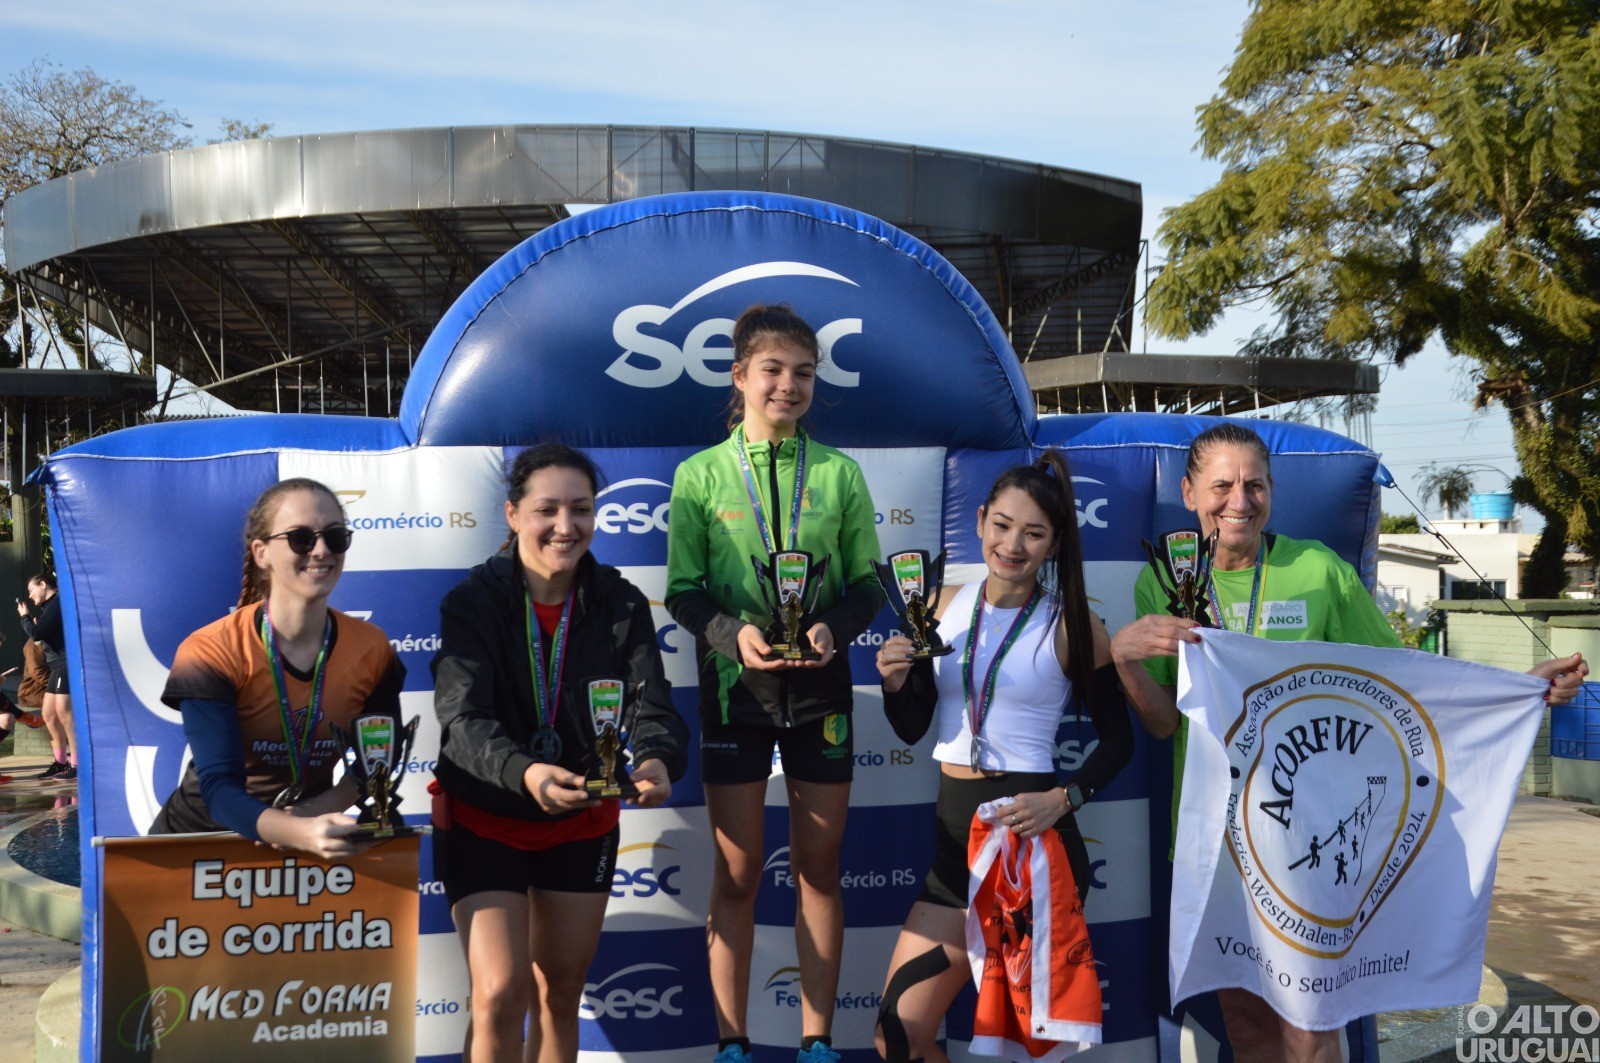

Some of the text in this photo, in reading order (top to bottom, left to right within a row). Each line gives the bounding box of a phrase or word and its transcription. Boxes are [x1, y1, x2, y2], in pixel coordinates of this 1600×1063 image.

[604, 304, 862, 388] Sec
[344, 511, 477, 530] comércio RS
[594, 502, 670, 534] esc
[890, 508, 915, 525] RS
[1267, 615, 1304, 625] ANOS
[1288, 674, 1306, 692] de
[1310, 670, 1397, 711] Corredores
[1393, 705, 1412, 727] de
[1405, 724, 1424, 758] Rua
[890, 749, 914, 766] RS
[1259, 714, 1374, 830] ACORFW
[1369, 811, 1428, 906] Desde 2024
[192, 857, 355, 908] Equipe
[609, 865, 681, 898] esc
[774, 868, 916, 888] Feércio RS
[147, 910, 393, 960] de corrida
[1278, 972, 1292, 988] o
[1299, 976, 1333, 993] seu
[1358, 949, 1411, 979] limite!
[274, 980, 392, 1017] FORMA
[252, 1016, 389, 1043] Academia
